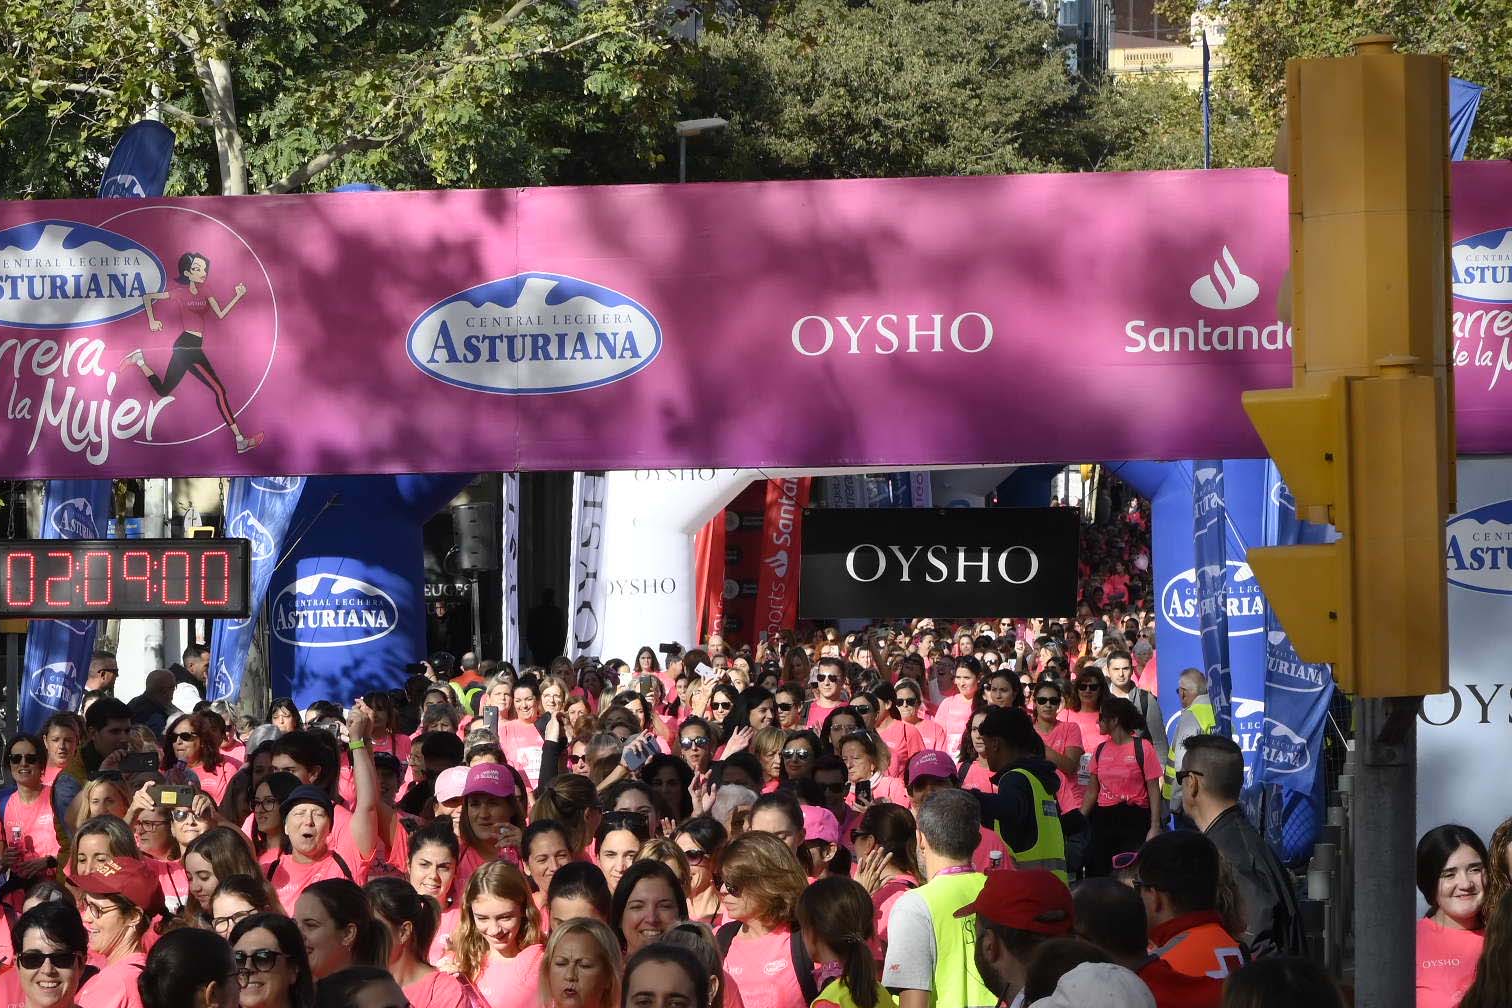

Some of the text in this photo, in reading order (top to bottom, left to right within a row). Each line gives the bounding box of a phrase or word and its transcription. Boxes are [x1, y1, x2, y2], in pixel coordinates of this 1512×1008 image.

[68, 255, 142, 268] LECHERA
[466, 312, 633, 328] CENTRAL LECHERA
[791, 311, 994, 357] OYSHO
[427, 319, 642, 365] ASTURIANA
[6, 380, 32, 421] la
[28, 372, 176, 466] Mujer
[7, 551, 229, 606] 02:09:00
[845, 543, 1039, 585] OYSHO
[275, 604, 389, 631] ASTURIANA
[1422, 958, 1460, 969] OYSHO
